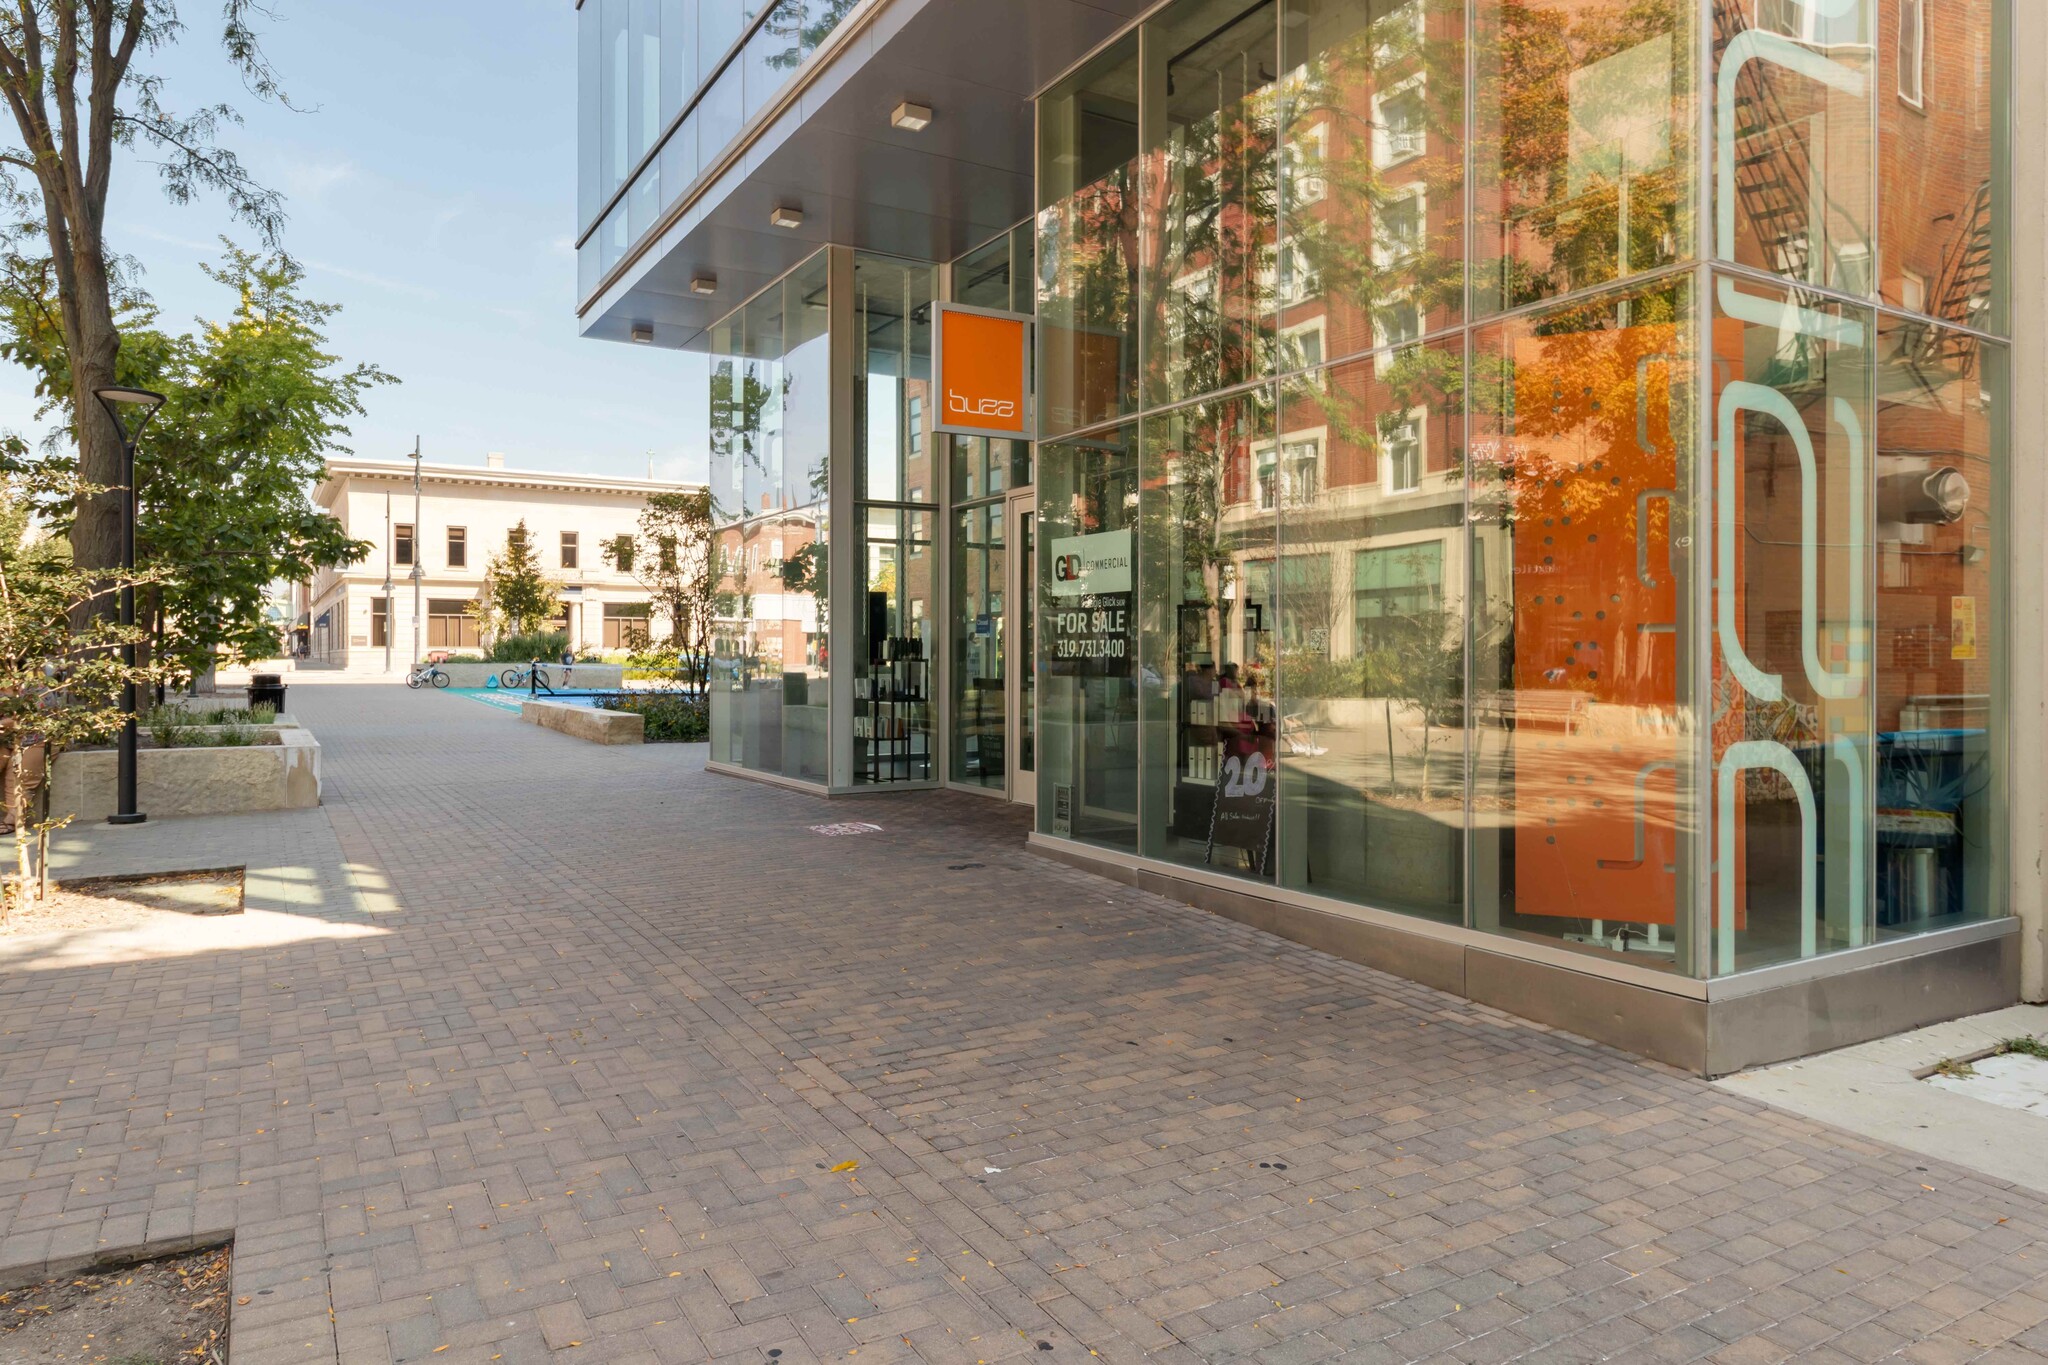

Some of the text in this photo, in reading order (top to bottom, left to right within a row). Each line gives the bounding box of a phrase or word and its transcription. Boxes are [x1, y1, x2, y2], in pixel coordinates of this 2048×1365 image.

[949, 388, 1015, 418] buzz
[1085, 557, 1128, 571] COMMERCIAL
[1057, 610, 1125, 634] FOR SALE
[1057, 639, 1124, 658] 319.731.3400
